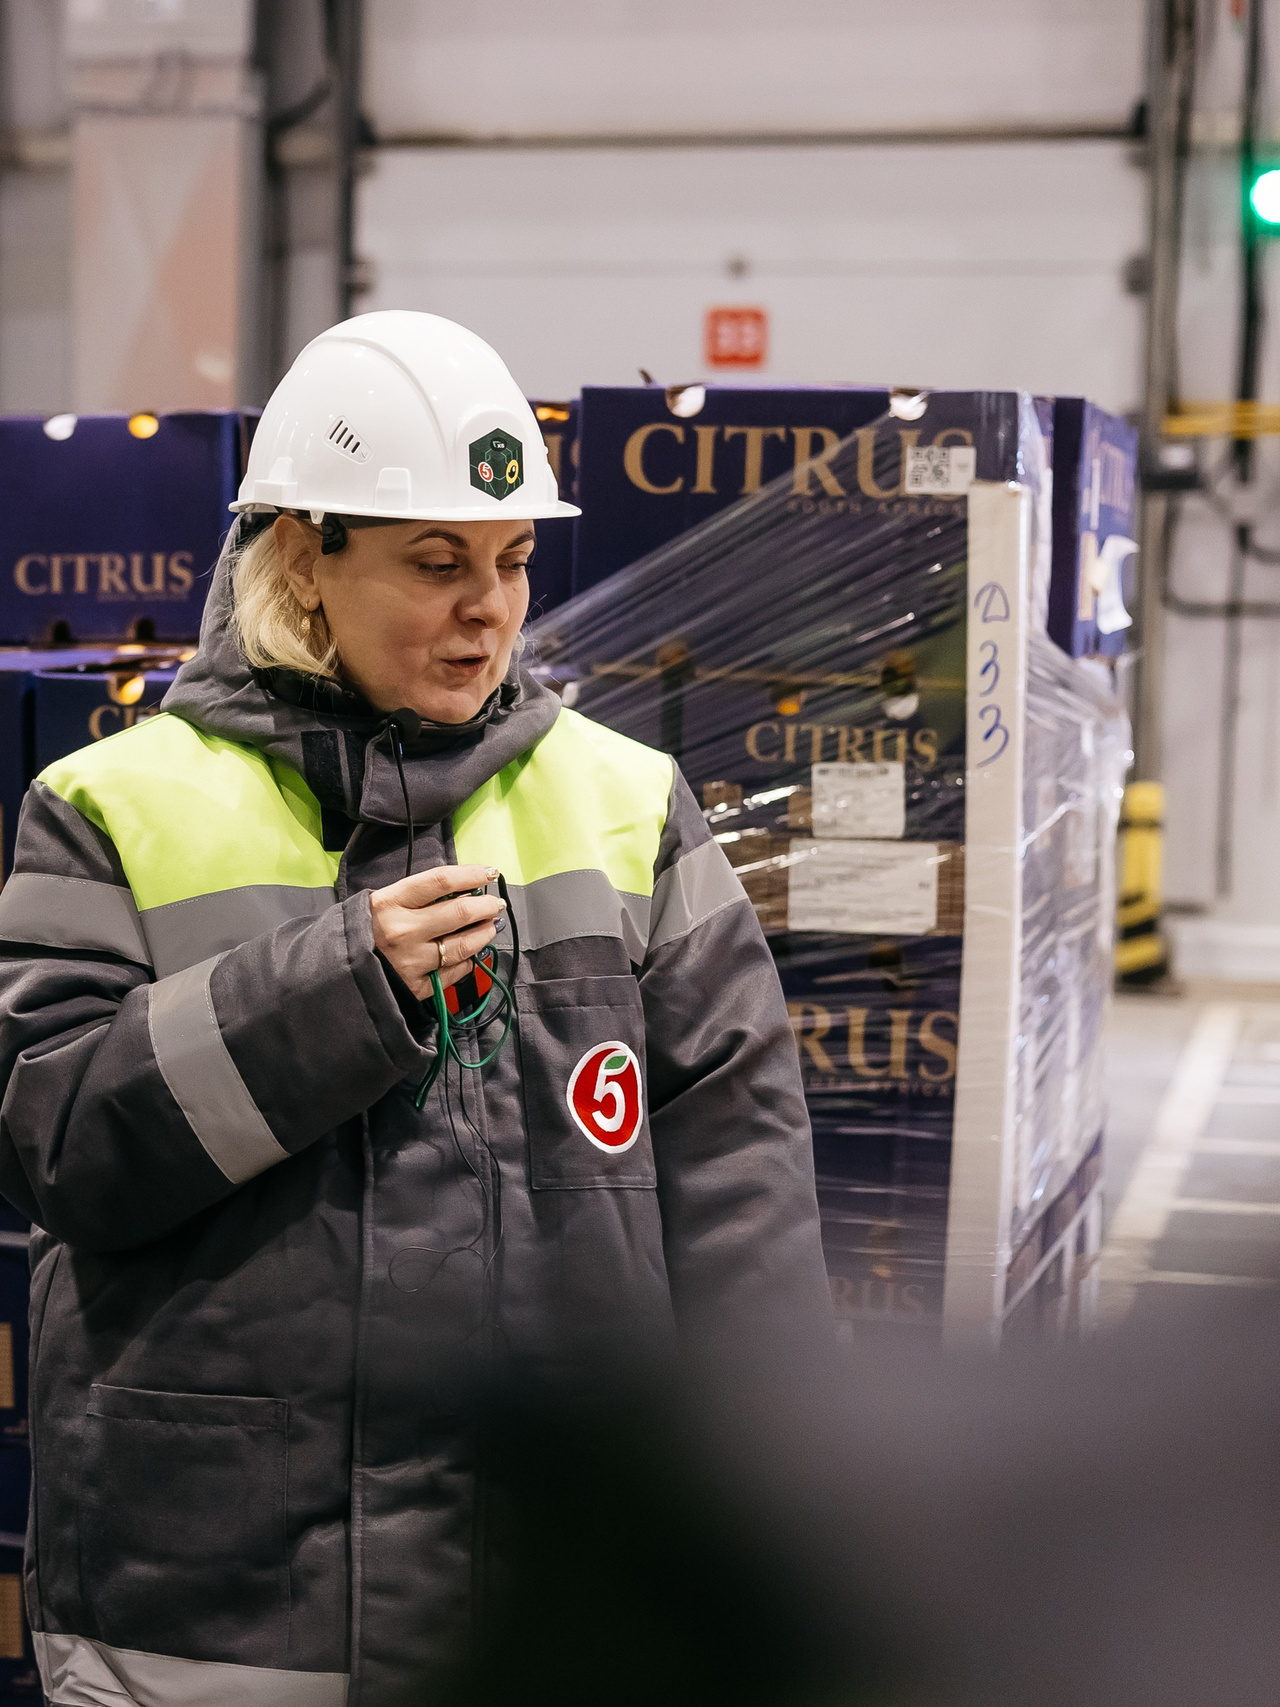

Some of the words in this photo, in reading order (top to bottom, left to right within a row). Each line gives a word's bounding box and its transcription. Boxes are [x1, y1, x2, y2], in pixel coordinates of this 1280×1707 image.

[13, 552, 194, 595] CITRUS
[745, 721, 939, 771] CITRUS
[592, 1050, 630, 1132] 5
